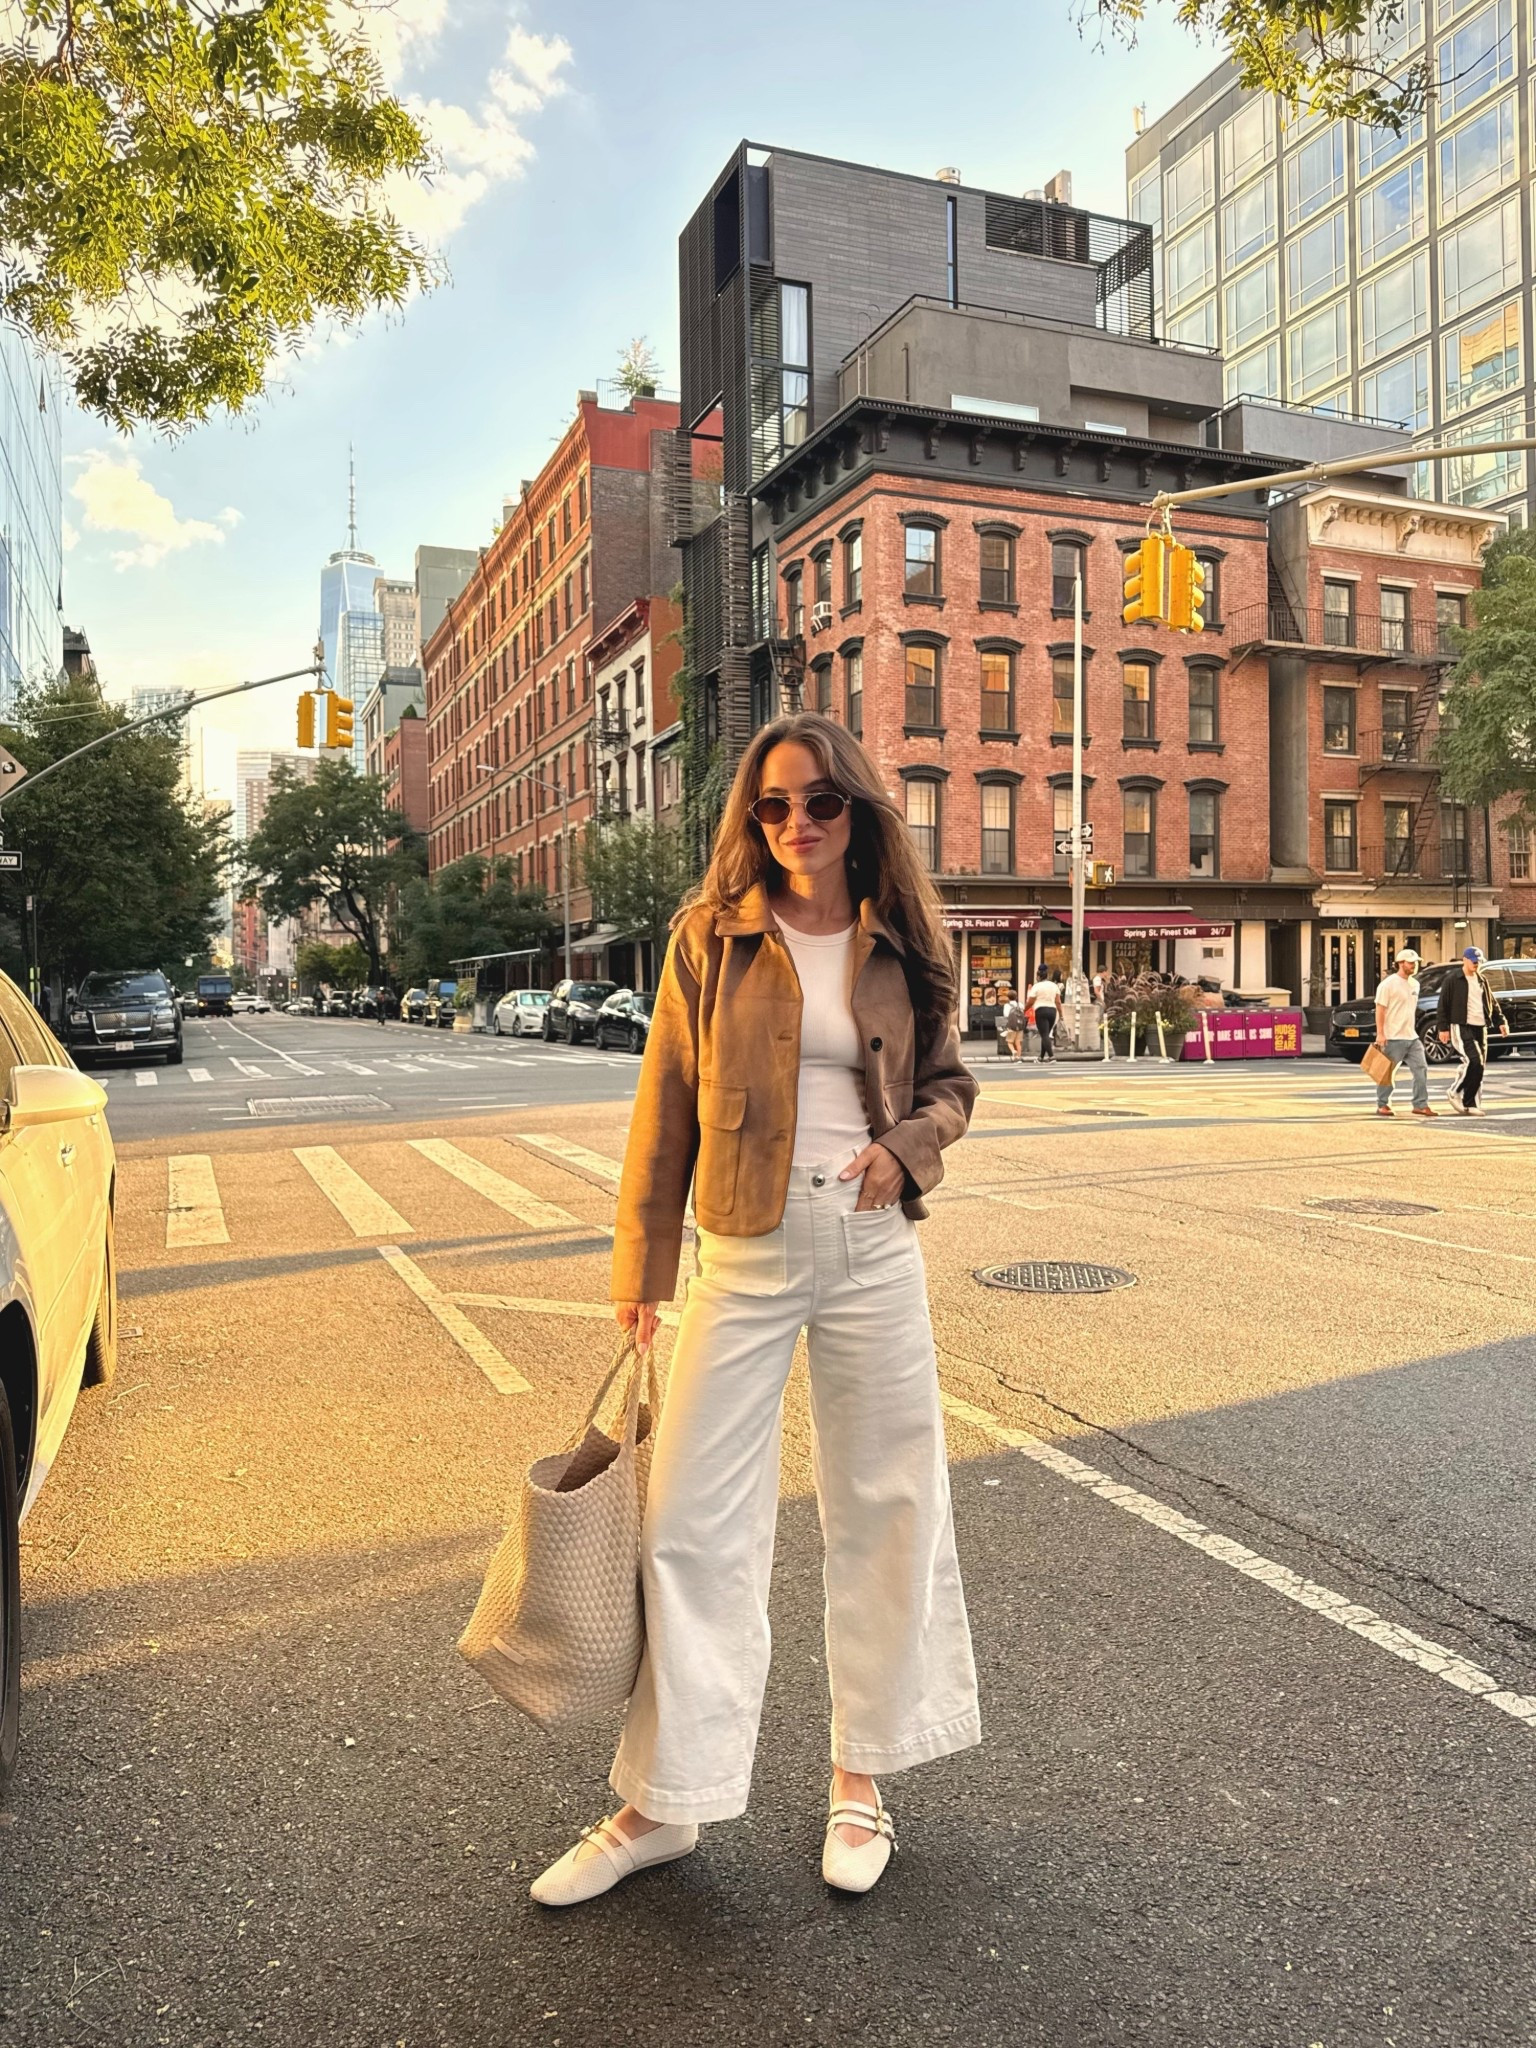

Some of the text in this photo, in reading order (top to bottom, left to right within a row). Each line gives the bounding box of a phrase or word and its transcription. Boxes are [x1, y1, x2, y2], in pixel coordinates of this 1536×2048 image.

[942, 919, 1034, 929] Spring St. Finest Deli 24/7
[1123, 927, 1225, 938] Spring St. Finest Deli 24/7
